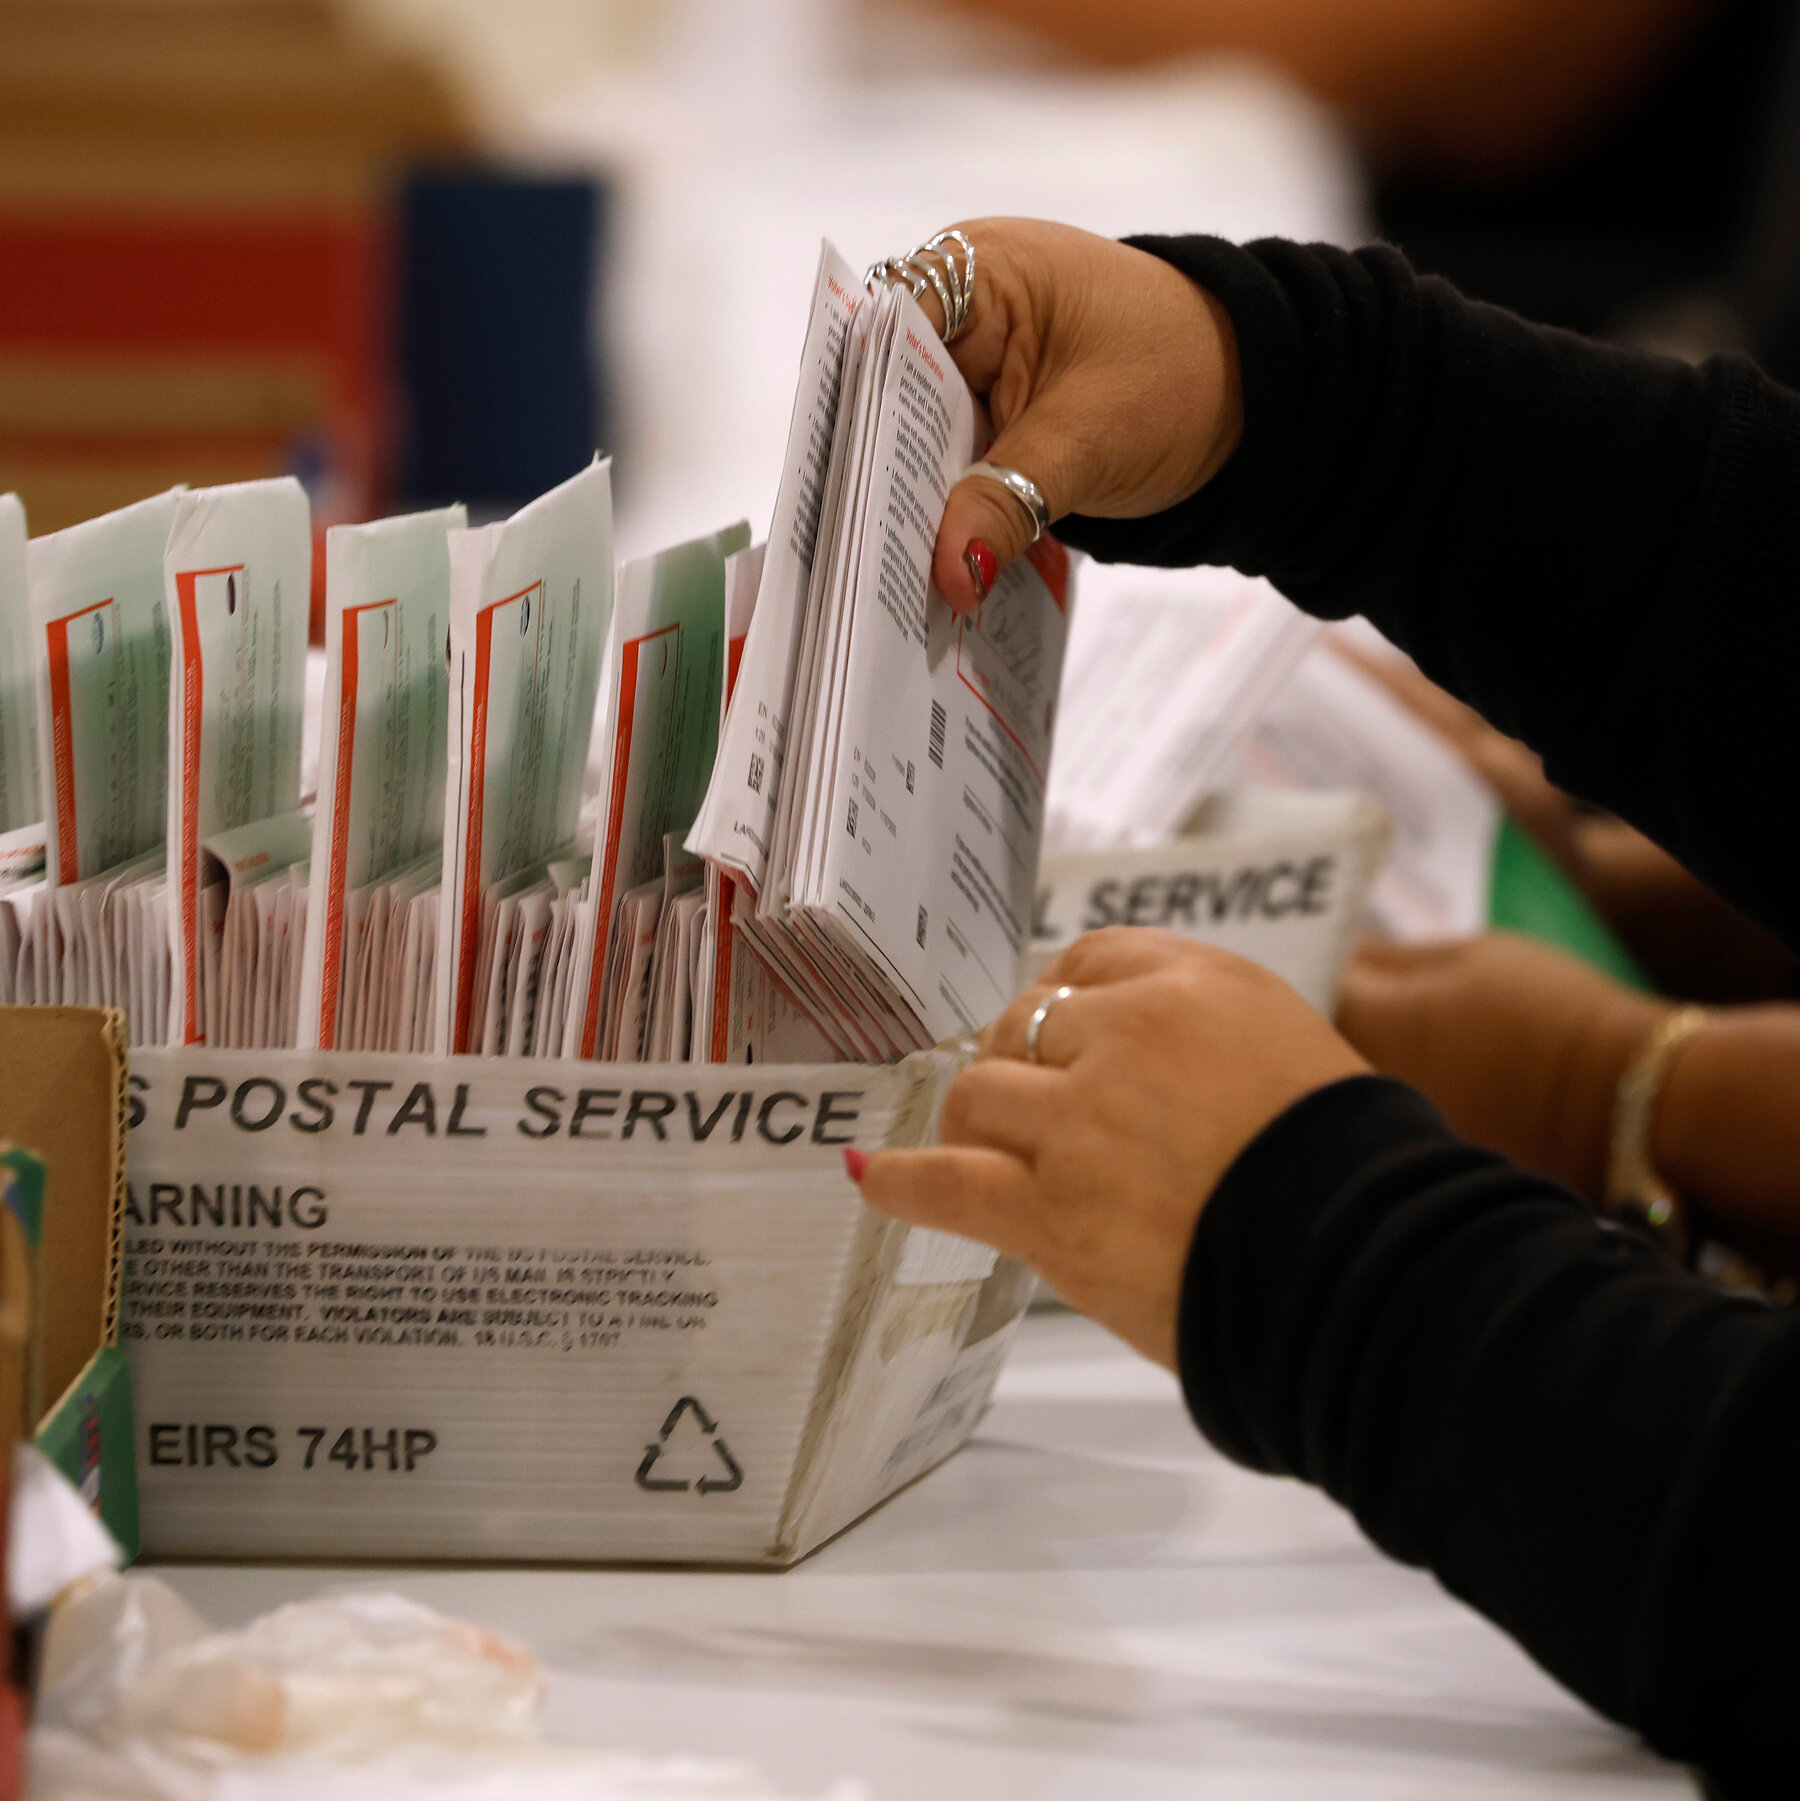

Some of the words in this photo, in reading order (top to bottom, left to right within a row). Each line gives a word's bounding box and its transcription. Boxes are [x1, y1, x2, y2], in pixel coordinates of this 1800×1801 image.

[906, 327, 922, 356] Voter's
[921, 344, 944, 383] Declaration
[1082, 855, 1335, 930] SERVICE
[173, 1075, 488, 1136] POSTAL
[516, 1085, 866, 1145] SERVICE
[125, 1183, 328, 1230] ARNING
[169, 1240, 258, 1257] WITHOUT
[263, 1241, 302, 1257] THE
[307, 1241, 428, 1261] PERMISSION
[432, 1246, 457, 1261] OF
[142, 1259, 210, 1278] OTHER
[217, 1260, 270, 1279] THAN
[275, 1261, 313, 1280] THE
[319, 1262, 435, 1282] TRANSPORT
[441, 1264, 467, 1283] OF
[472, 1265, 500, 1284] US
[504, 1265, 547, 1284] MAIL
[580, 1268, 676, 1286] STRICTLY
[192, 1281, 297, 1300] RESERVES
[302, 1283, 340, 1301] THE
[345, 1285, 405, 1302] RIGHT
[409, 1286, 438, 1302] TO
[441, 1286, 481, 1303] USE
[485, 1287, 611, 1307] ELECTRONIC
[615, 1290, 719, 1308] TRACKING
[129, 1300, 186, 1319] THEIR
[320, 1305, 432, 1324] VIOLATORS
[436, 1308, 477, 1326] ARE
[482, 1309, 570, 1327] SUBJECT
[579, 1311, 604, 1328] TO
[154, 1322, 184, 1340] OR
[189, 1322, 245, 1342] BOTH
[249, 1323, 289, 1343] FOR
[294, 1324, 349, 1344] EACH
[149, 1423, 279, 1469] EIRS
[296, 1426, 438, 1472] 74HP
